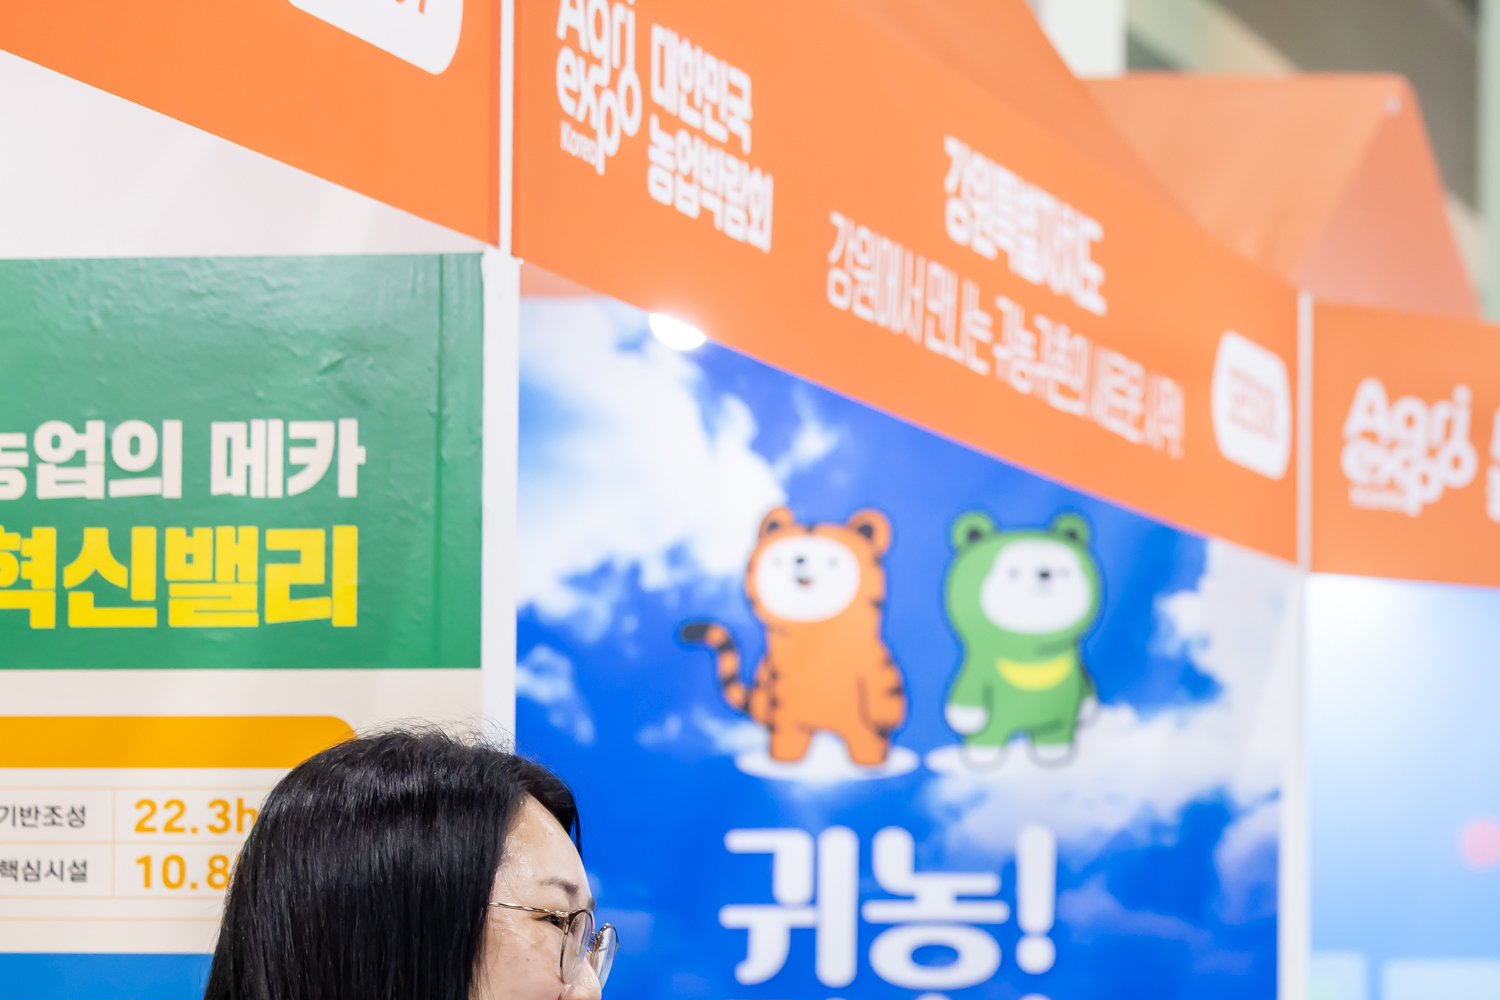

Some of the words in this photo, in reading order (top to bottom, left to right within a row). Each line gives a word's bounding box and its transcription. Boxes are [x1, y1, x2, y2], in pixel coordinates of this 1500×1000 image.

[556, 0, 636, 87] Agri
[650, 23, 753, 155] 대한민국
[556, 46, 643, 176] expo
[647, 113, 774, 254] 농업박람회
[211, 418, 366, 499] 메카
[1342, 377, 1473, 456] Agri
[719, 825, 1057, 990] 귀농!
